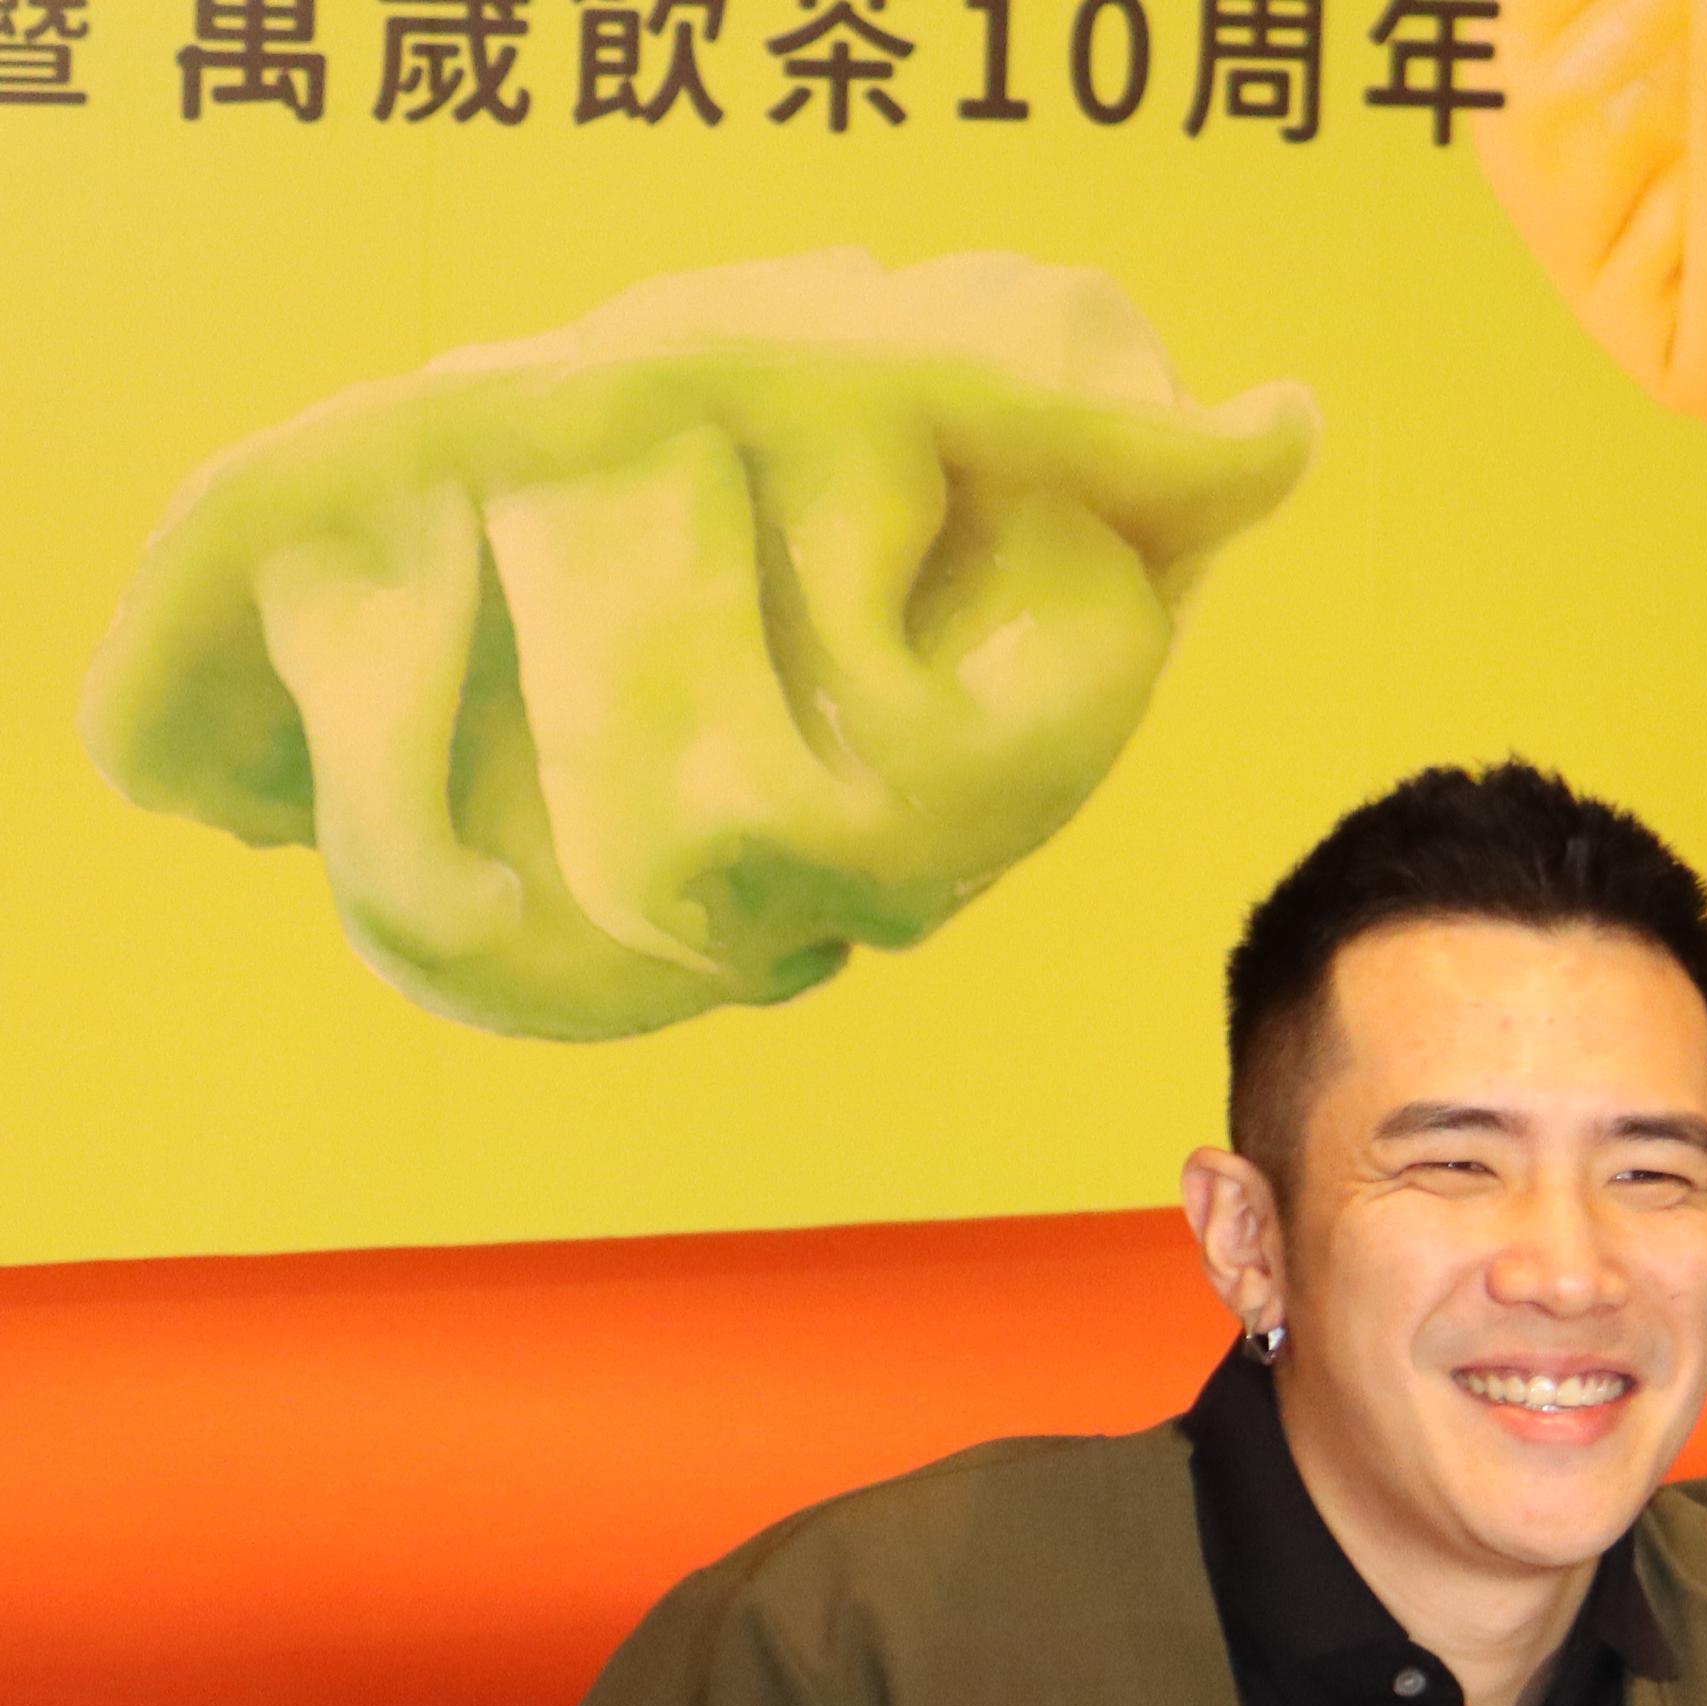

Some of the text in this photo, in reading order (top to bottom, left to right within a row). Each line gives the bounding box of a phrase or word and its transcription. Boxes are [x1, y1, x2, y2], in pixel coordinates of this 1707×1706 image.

[176, 0, 1506, 146] 萬歲飲茶10周年
